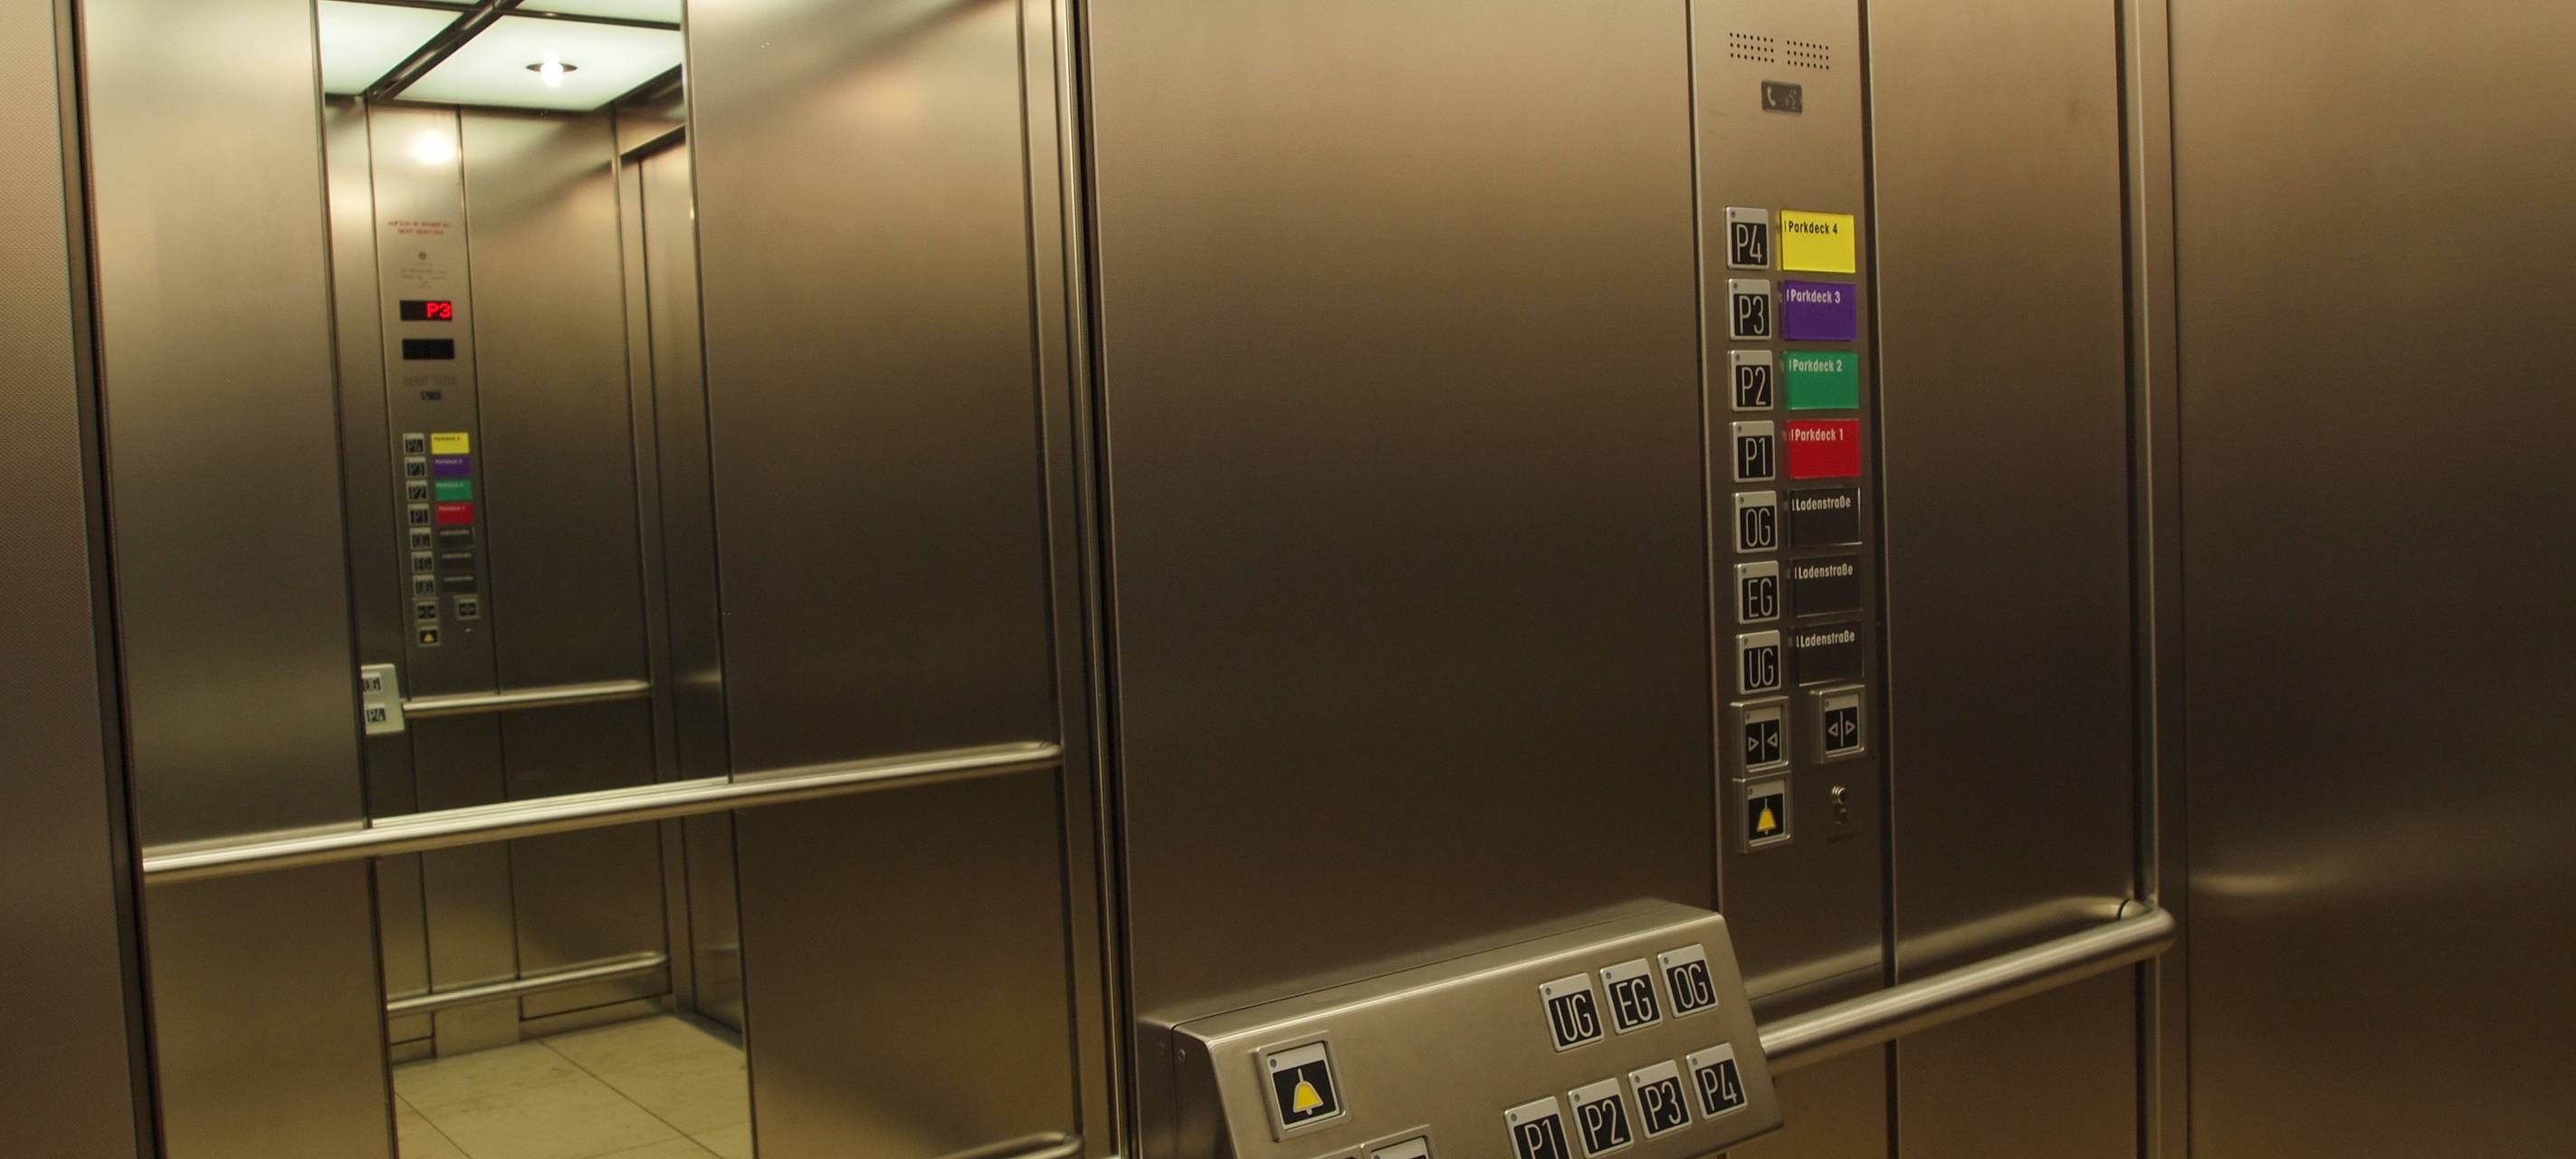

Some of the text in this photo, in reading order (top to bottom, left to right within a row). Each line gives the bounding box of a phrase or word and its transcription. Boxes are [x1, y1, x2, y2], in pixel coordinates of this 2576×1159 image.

[1736, 224, 1763, 263] P4
[1789, 221, 1838, 235] Parkdeck 4
[426, 302, 452, 319] P3
[1739, 295, 1765, 334] P3
[1791, 289, 1841, 303] Parkdeck 3
[1793, 359, 1843, 373] Parkdeck 2
[1741, 367, 1767, 406] P2
[1795, 428, 1844, 442] Parkdeck 1
[1745, 437, 1766, 477] P1
[1796, 495, 1852, 512] Ladenstraße
[1745, 508, 1771, 547] OG
[1798, 563, 1854, 580] Ladenstraße
[1748, 578, 1773, 618] EG
[1800, 629, 1856, 648] Ladenstraße
[1749, 647, 1774, 688] UG
[1616, 979, 1653, 1026] EG
[1674, 963, 1709, 1010] OG
[1555, 994, 1594, 1042] UG
[1645, 1081, 1682, 1131] P3
[1701, 1064, 1737, 1112] P4
[1524, 1119, 1559, 1159] P1
[1585, 1099, 1624, 1150] P2
